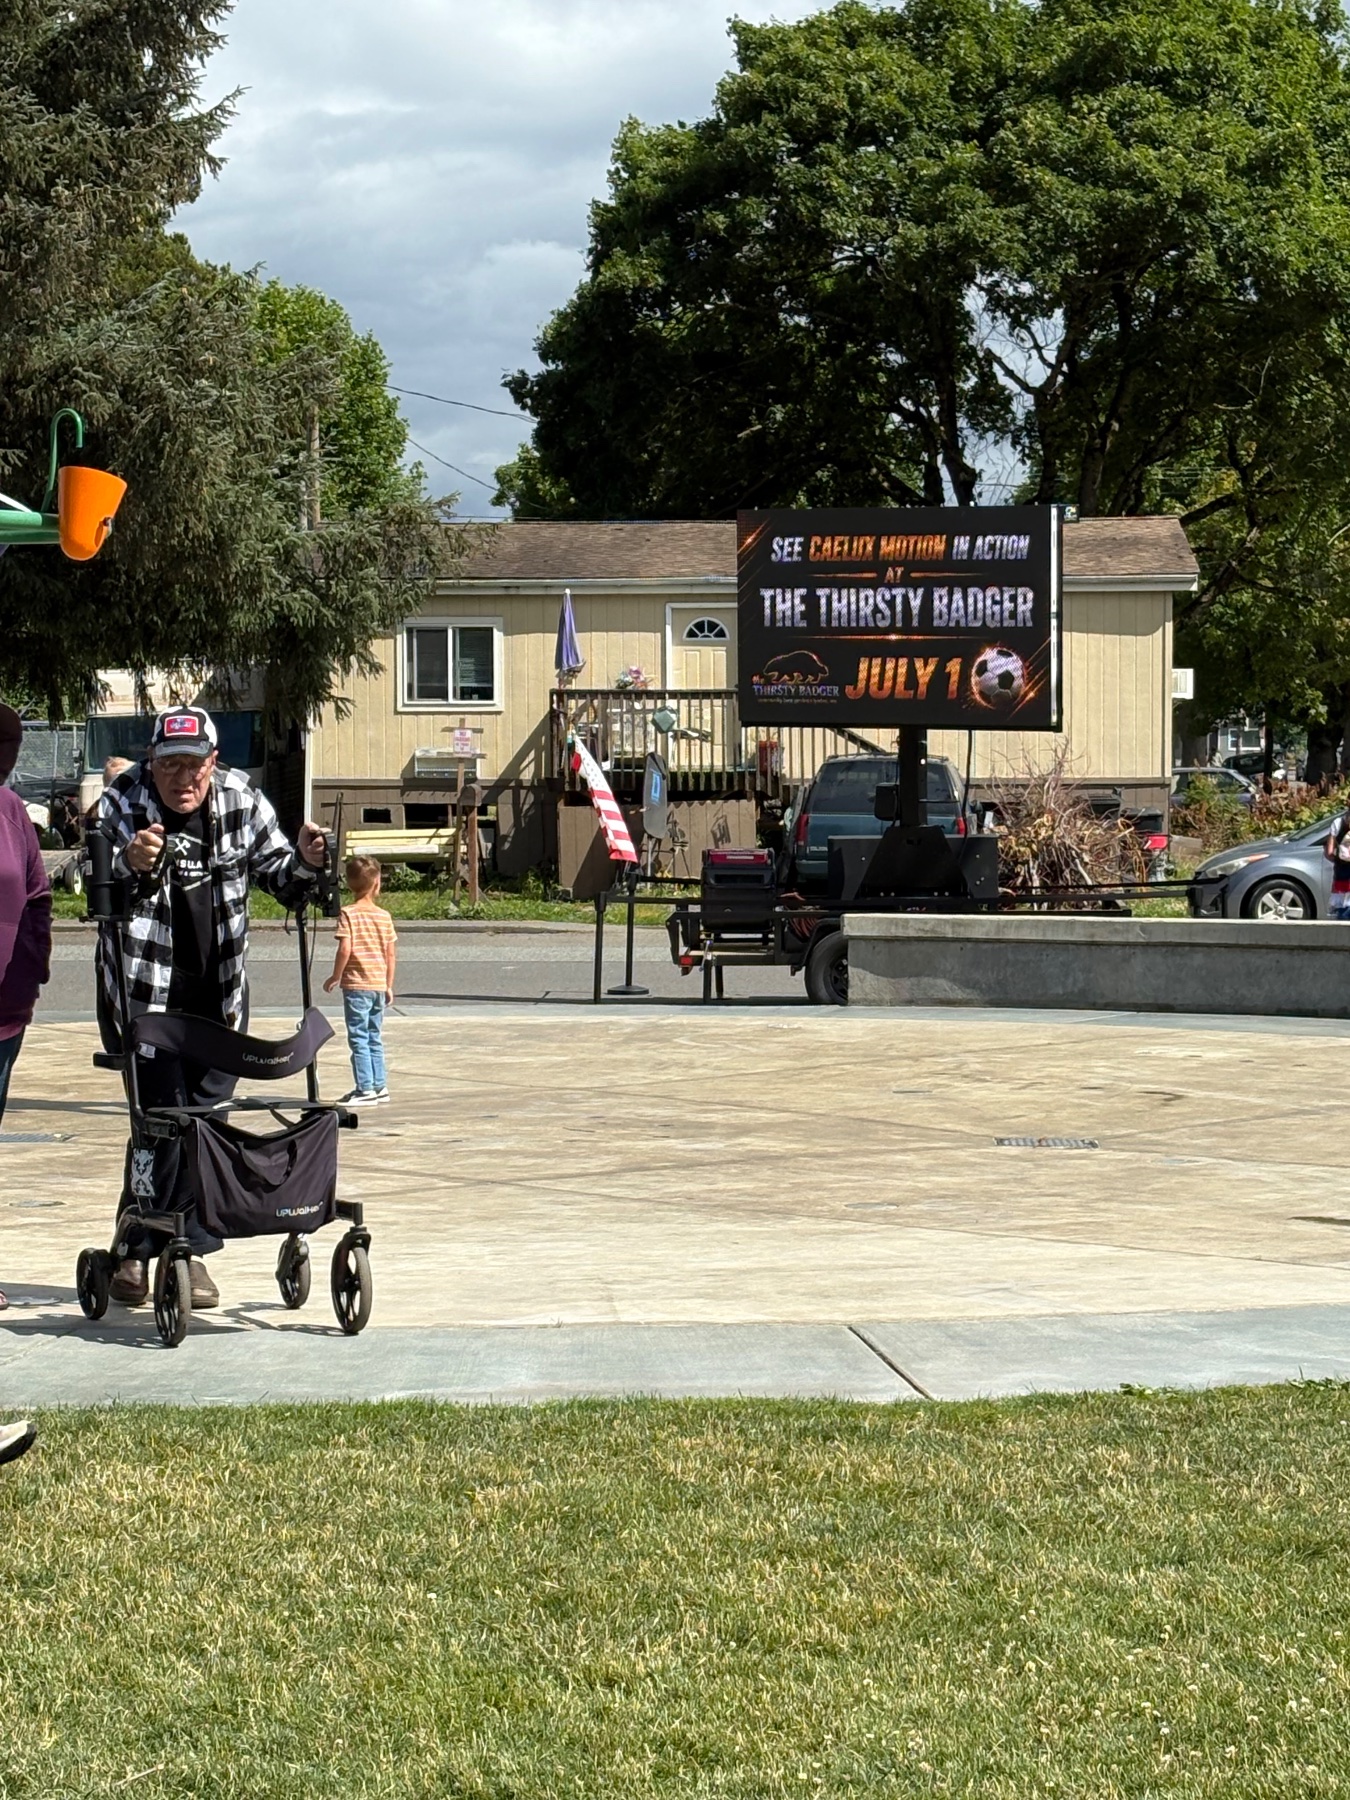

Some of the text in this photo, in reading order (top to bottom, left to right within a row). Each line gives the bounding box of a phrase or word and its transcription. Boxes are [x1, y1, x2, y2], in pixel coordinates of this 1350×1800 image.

[771, 534, 1030, 562] SEE CAELUX MOTION IN ACTION
[884, 566, 904, 583] AT
[759, 586, 1034, 628] THE THIRSTY BADGER
[752, 684, 840, 697] THIRSTY BADGER
[845, 657, 962, 700] JULY 1
